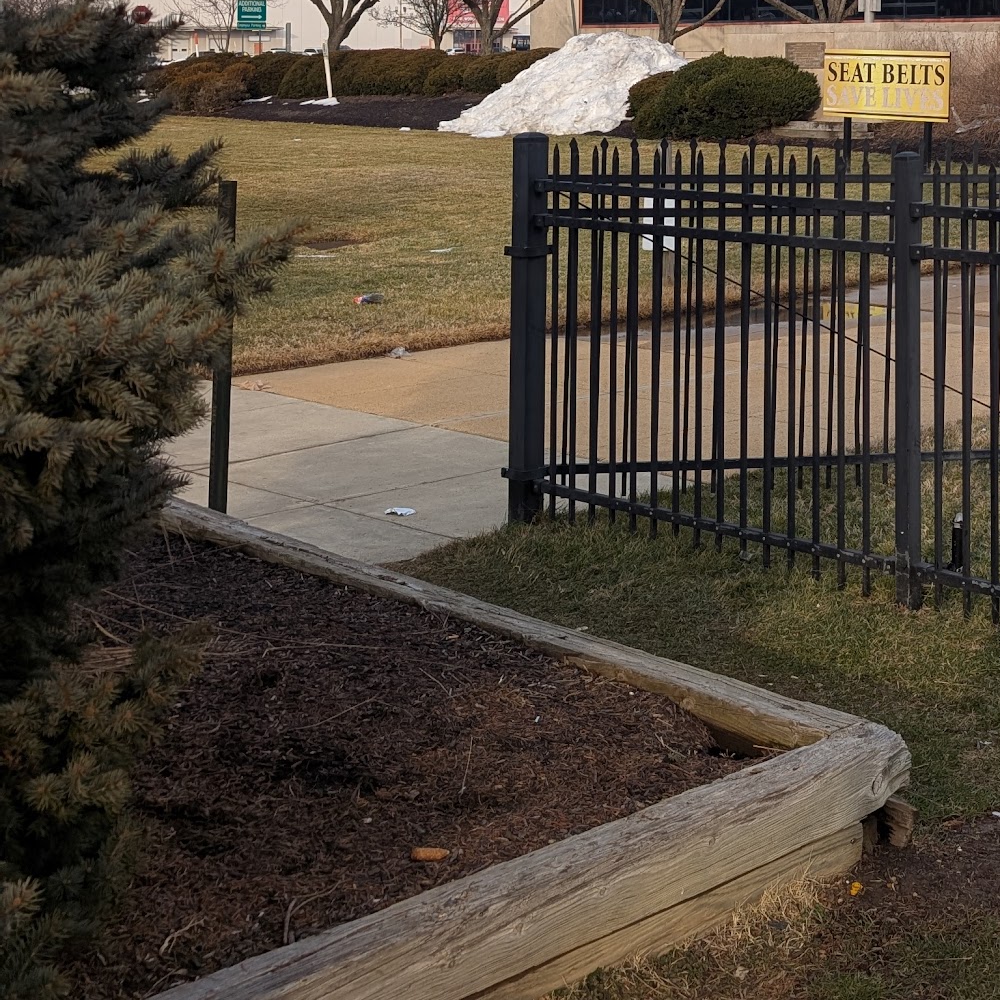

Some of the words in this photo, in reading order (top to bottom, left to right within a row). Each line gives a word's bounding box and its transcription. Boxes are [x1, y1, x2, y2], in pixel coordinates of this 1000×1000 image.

[827, 62, 876, 83] SEAT
[881, 63, 945, 86] BELTS
[826, 84, 876, 107] SAVE
[881, 86, 944, 111] LIVES
